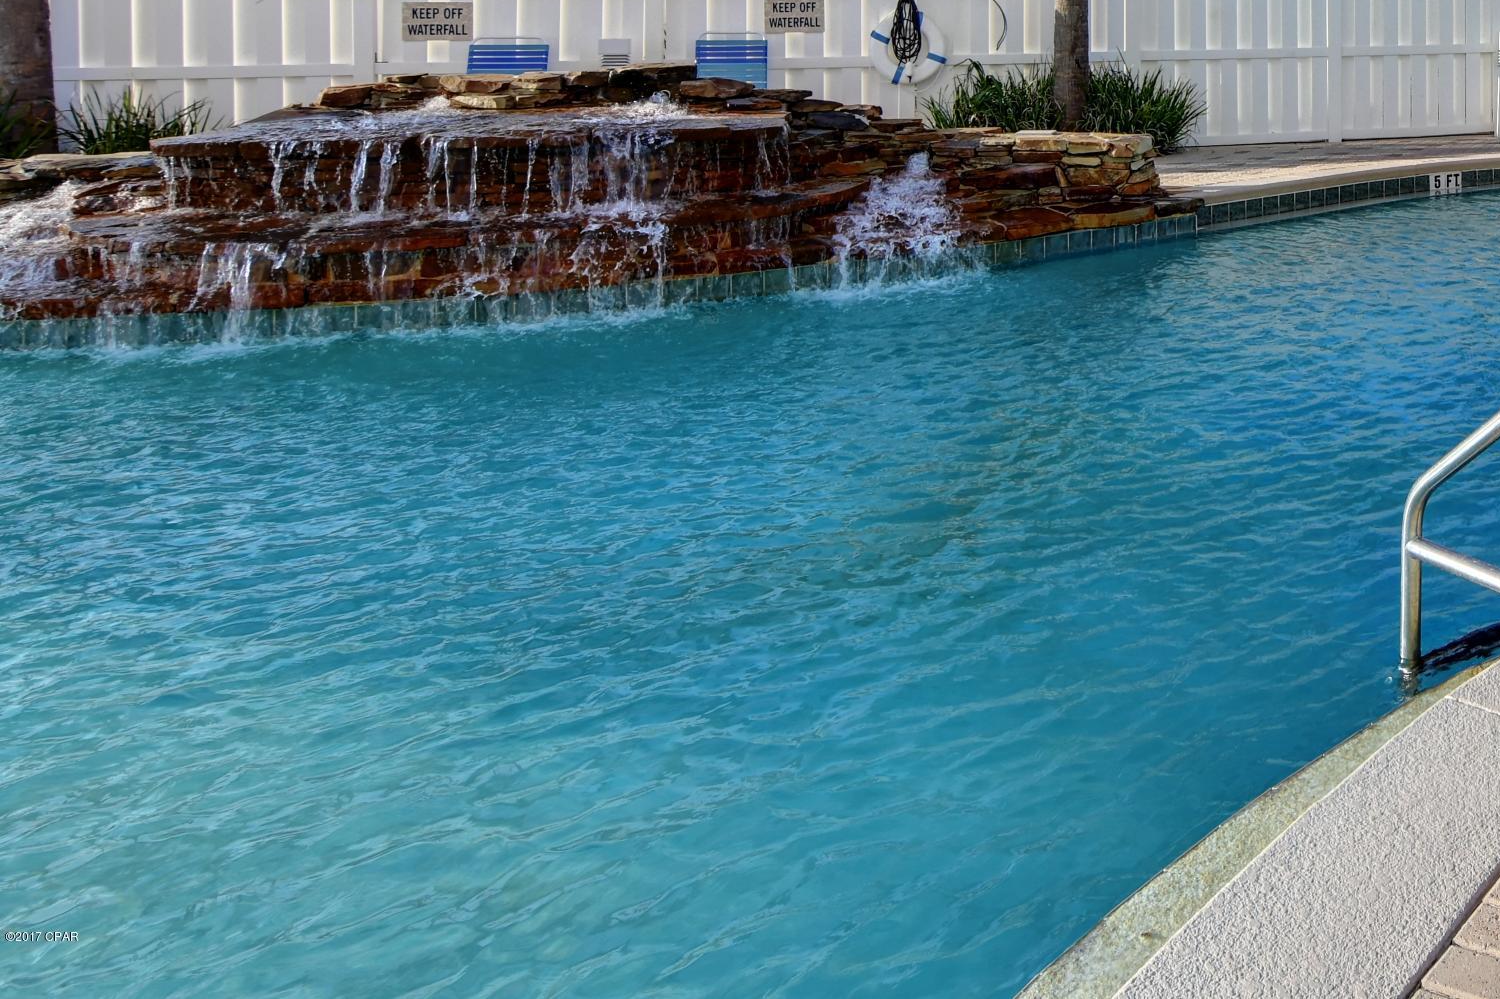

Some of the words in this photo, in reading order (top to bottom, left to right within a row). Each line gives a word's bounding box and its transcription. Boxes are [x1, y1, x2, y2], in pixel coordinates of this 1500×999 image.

[772, 2, 796, 13] KEEP
[799, 2, 816, 12] OFF
[412, 8, 439, 19] KEEP
[443, 8, 463, 19] OFF
[769, 17, 821, 28] WATERFALL
[407, 24, 468, 35] WATERFALL
[1434, 174, 1441, 189] 5
